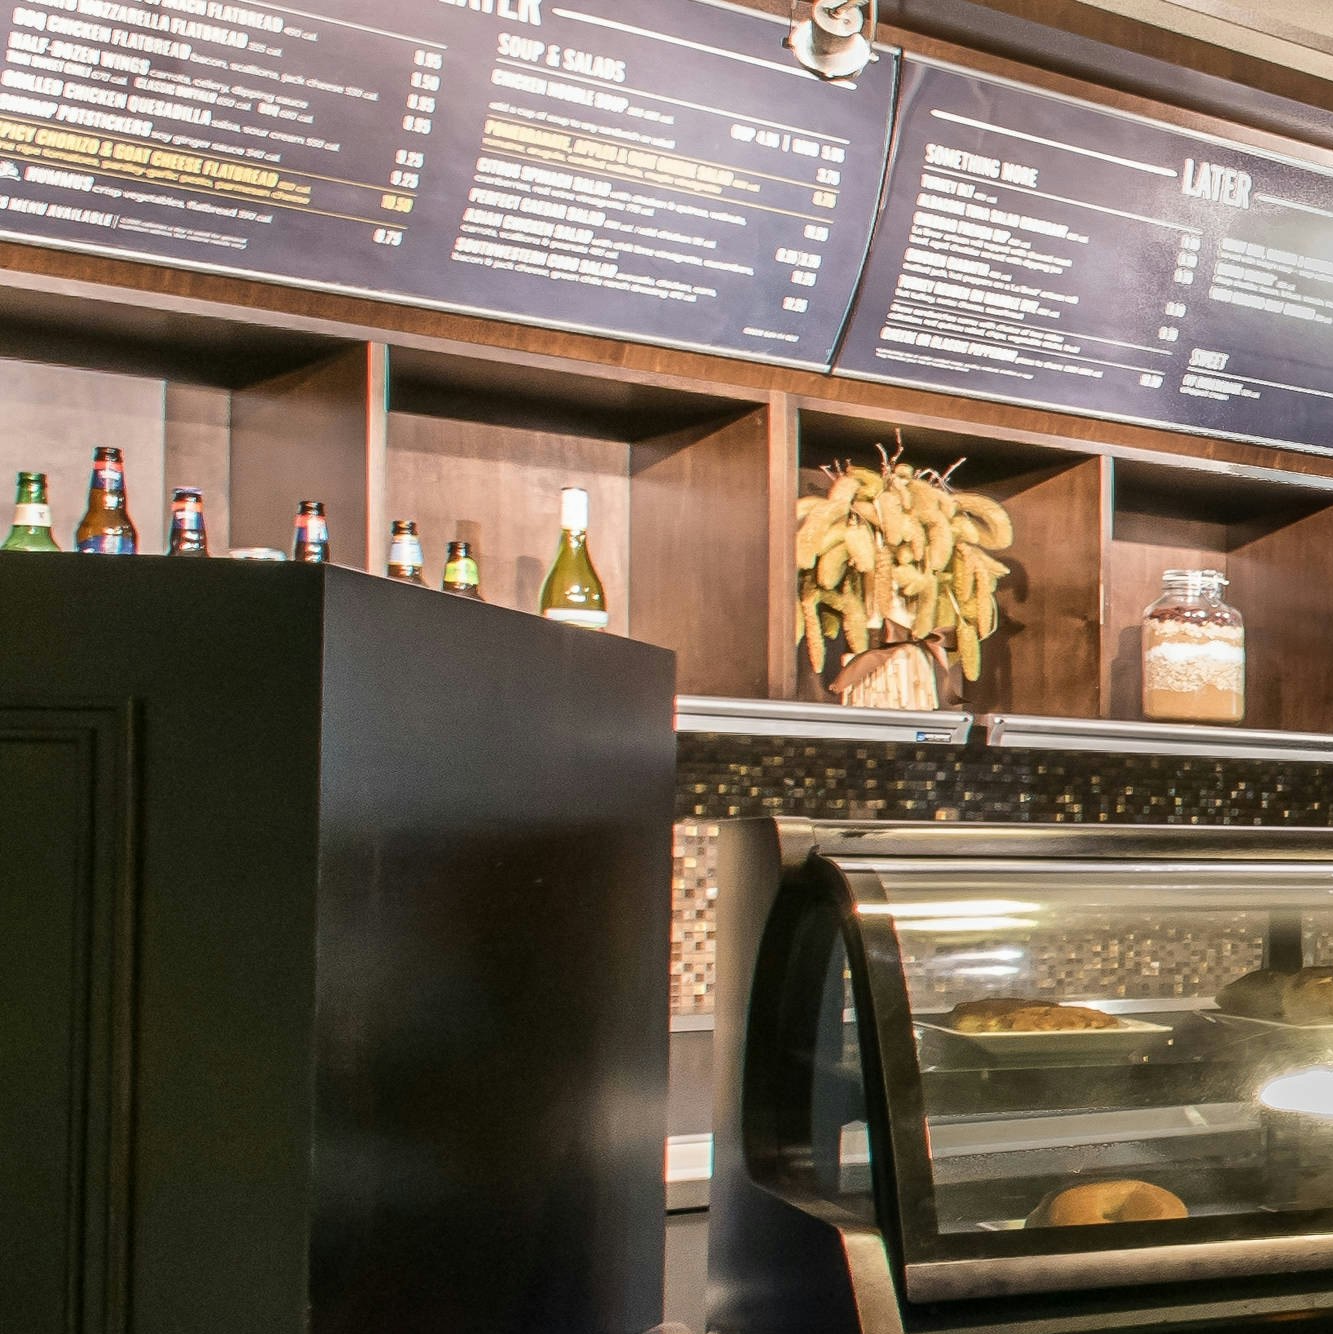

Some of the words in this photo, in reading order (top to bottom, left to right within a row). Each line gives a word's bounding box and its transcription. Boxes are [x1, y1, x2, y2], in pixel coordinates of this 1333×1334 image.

[47, 14, 112, 43] CHICKEN
[111, 29, 192, 60] FLATBREAD
[170, 17, 249, 49] FLATBREAD
[206, 1, 284, 33] FLATBREAD
[100, 51, 151, 76] WINGS
[496, 32, 545, 62] SOUP
[545, 44, 561, 68] &
[562, 48, 627, 83] SALADS
[63, 82, 128, 109] CHICKEN
[127, 95, 212, 126] QUESADILLA
[269, 131, 306, 145] cream
[35, 129, 101, 155] CHORIZO
[150, 151, 204, 174] CHEESE
[202, 160, 280, 188] FLATBREAD
[924, 143, 1001, 179] SOMETHING
[1001, 162, 1039, 188] MORE
[1182, 157, 1253, 210] LATER
